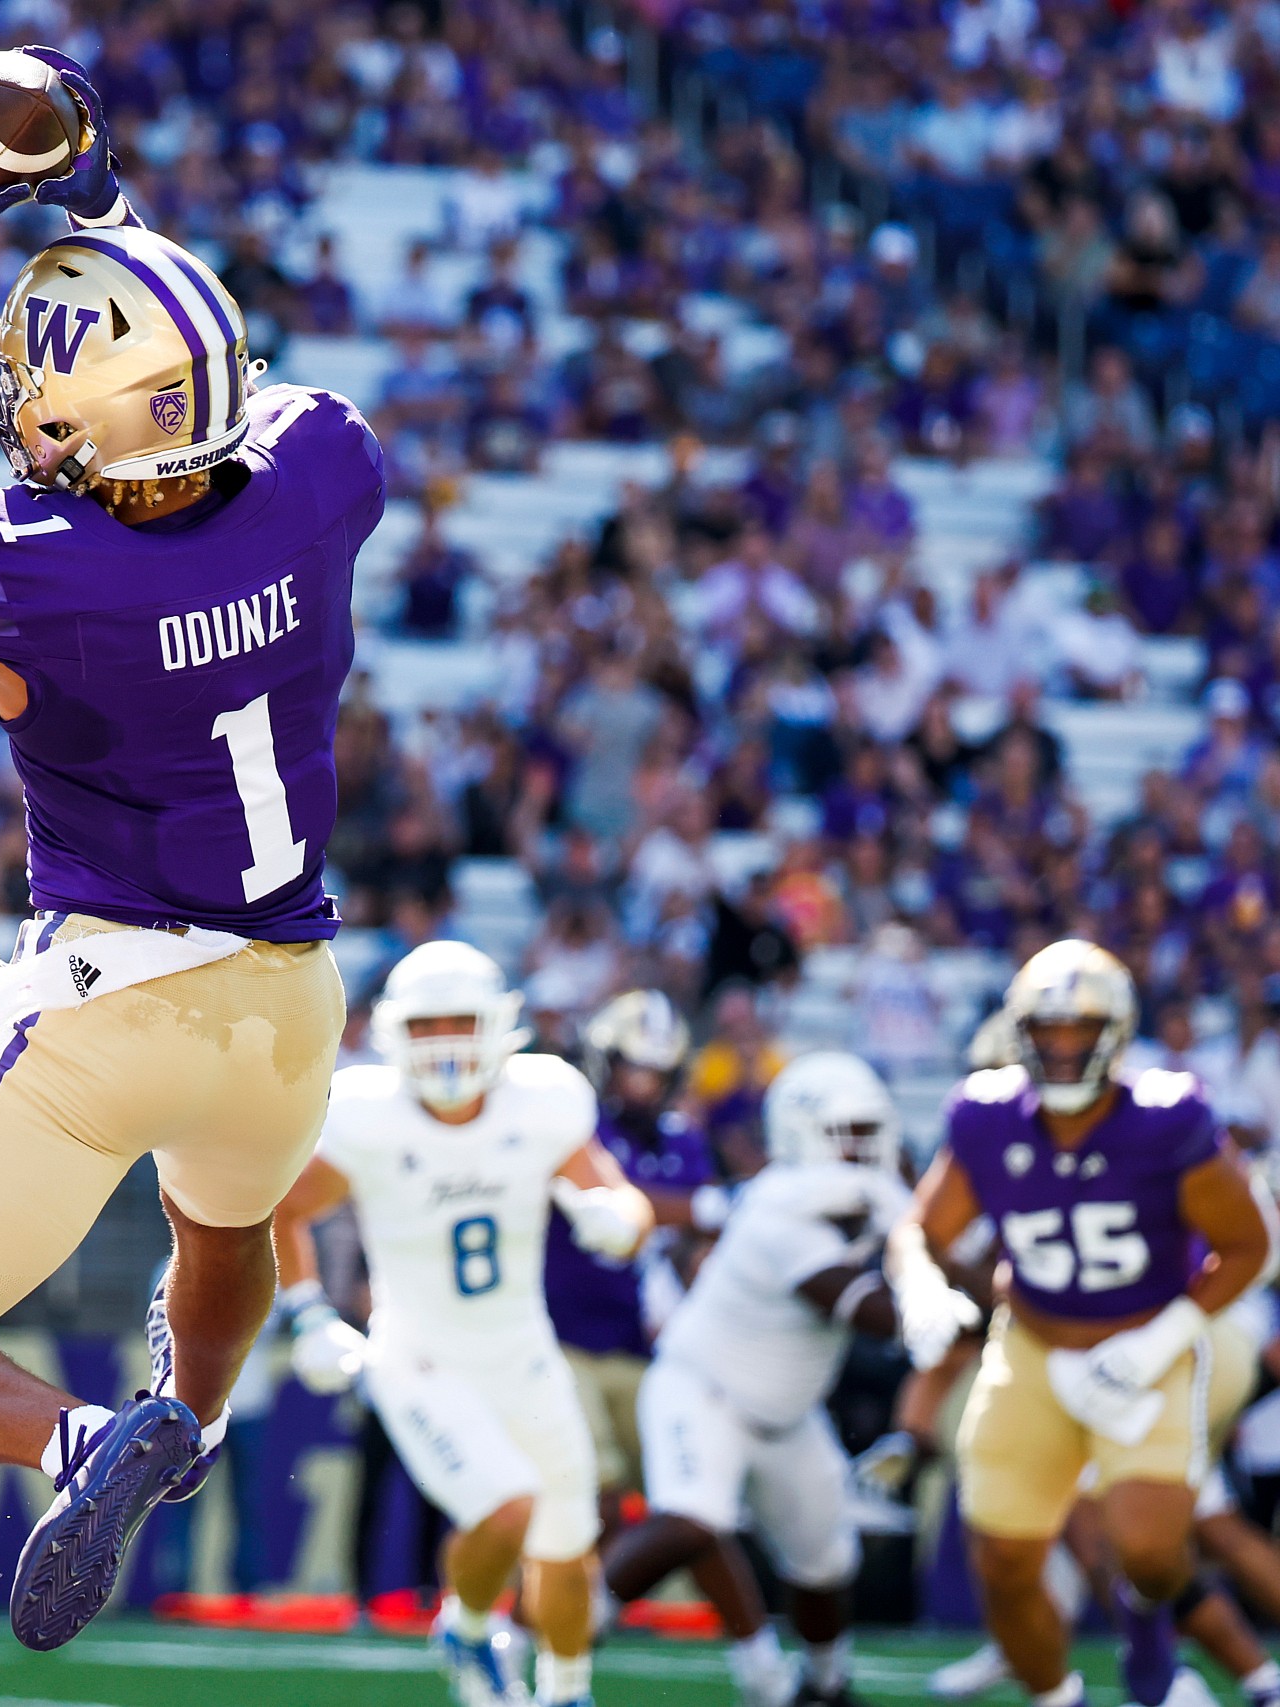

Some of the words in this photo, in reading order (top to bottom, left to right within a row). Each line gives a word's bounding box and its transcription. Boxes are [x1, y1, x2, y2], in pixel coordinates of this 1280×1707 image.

[24, 295, 102, 377] W
[152, 392, 187, 421] PAC
[162, 411, 180, 428] 12
[158, 573, 301, 672] ODUNZE
[210, 691, 308, 904] 1
[66, 952, 90, 999] adidas
[452, 1214, 502, 1297] 8
[1000, 1201, 1152, 1294] 55
